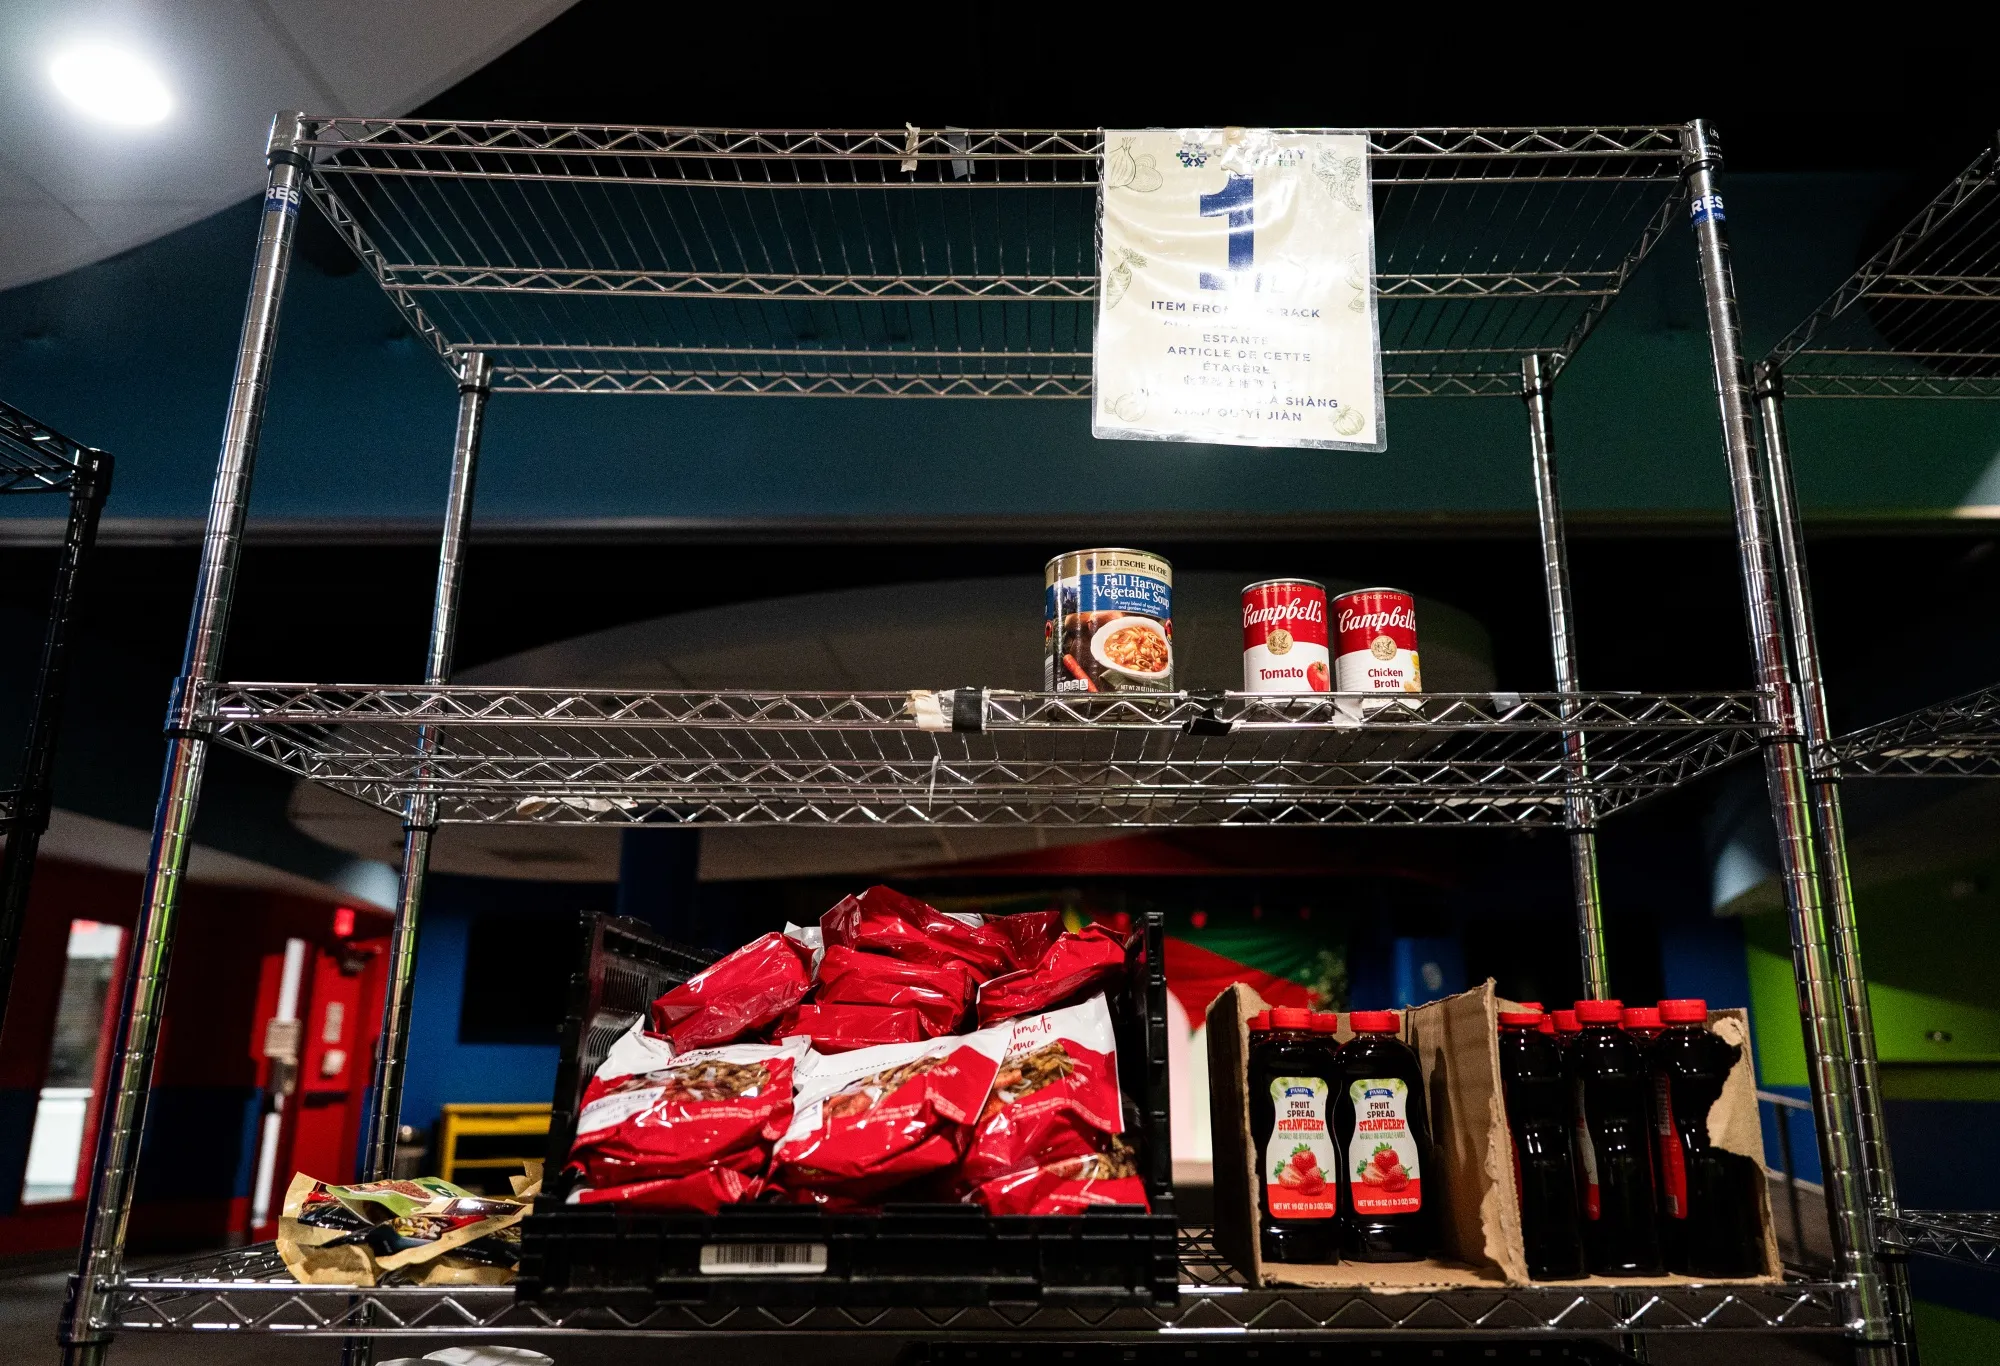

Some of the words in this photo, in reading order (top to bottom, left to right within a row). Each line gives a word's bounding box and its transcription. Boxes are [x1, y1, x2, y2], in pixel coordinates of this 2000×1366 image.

[1200, 172, 1284, 292] 1
[1151, 300, 1186, 312] ITEM
[1280, 308, 1320, 318] RACK
[1203, 333, 1269, 346] ESTANTE
[1167, 346, 1231, 358] ARTICLE
[1238, 350, 1258, 359] DE
[1263, 351, 1312, 362] CETTE
[1203, 360, 1271, 374] ÉTAGÈRE
[1286, 395, 1338, 408] SHÀNG
[1267, 409, 1302, 421] JIÀN
[1100, 559, 1146, 570] DEUTSCHE
[1148, 563, 1168, 576] KÜCHE
[1103, 574, 1127, 586] Fall
[1130, 576, 1166, 595] Harvest
[1256, 586, 1302, 595] CONDENSED
[1096, 585, 1150, 600] Vegetable
[1152, 591, 1170, 610] Soup
[1243, 597, 1322, 628] Campbell's
[1260, 666, 1303, 680] Tomato
[1368, 667, 1403, 678] Chicken
[1374, 679, 1400, 689] Broth
[1290, 1087, 1309, 1095] PAMPA
[1290, 1101, 1310, 1110] FRUIT
[1370, 1102, 1390, 1110] FRUIT
[1287, 1110, 1315, 1118] SPREAD
[1367, 1110, 1395, 1118] SPREAD
[1278, 1118, 1325, 1131] STRAWBERRY
[1359, 1119, 1405, 1132] STRAWBERRY
